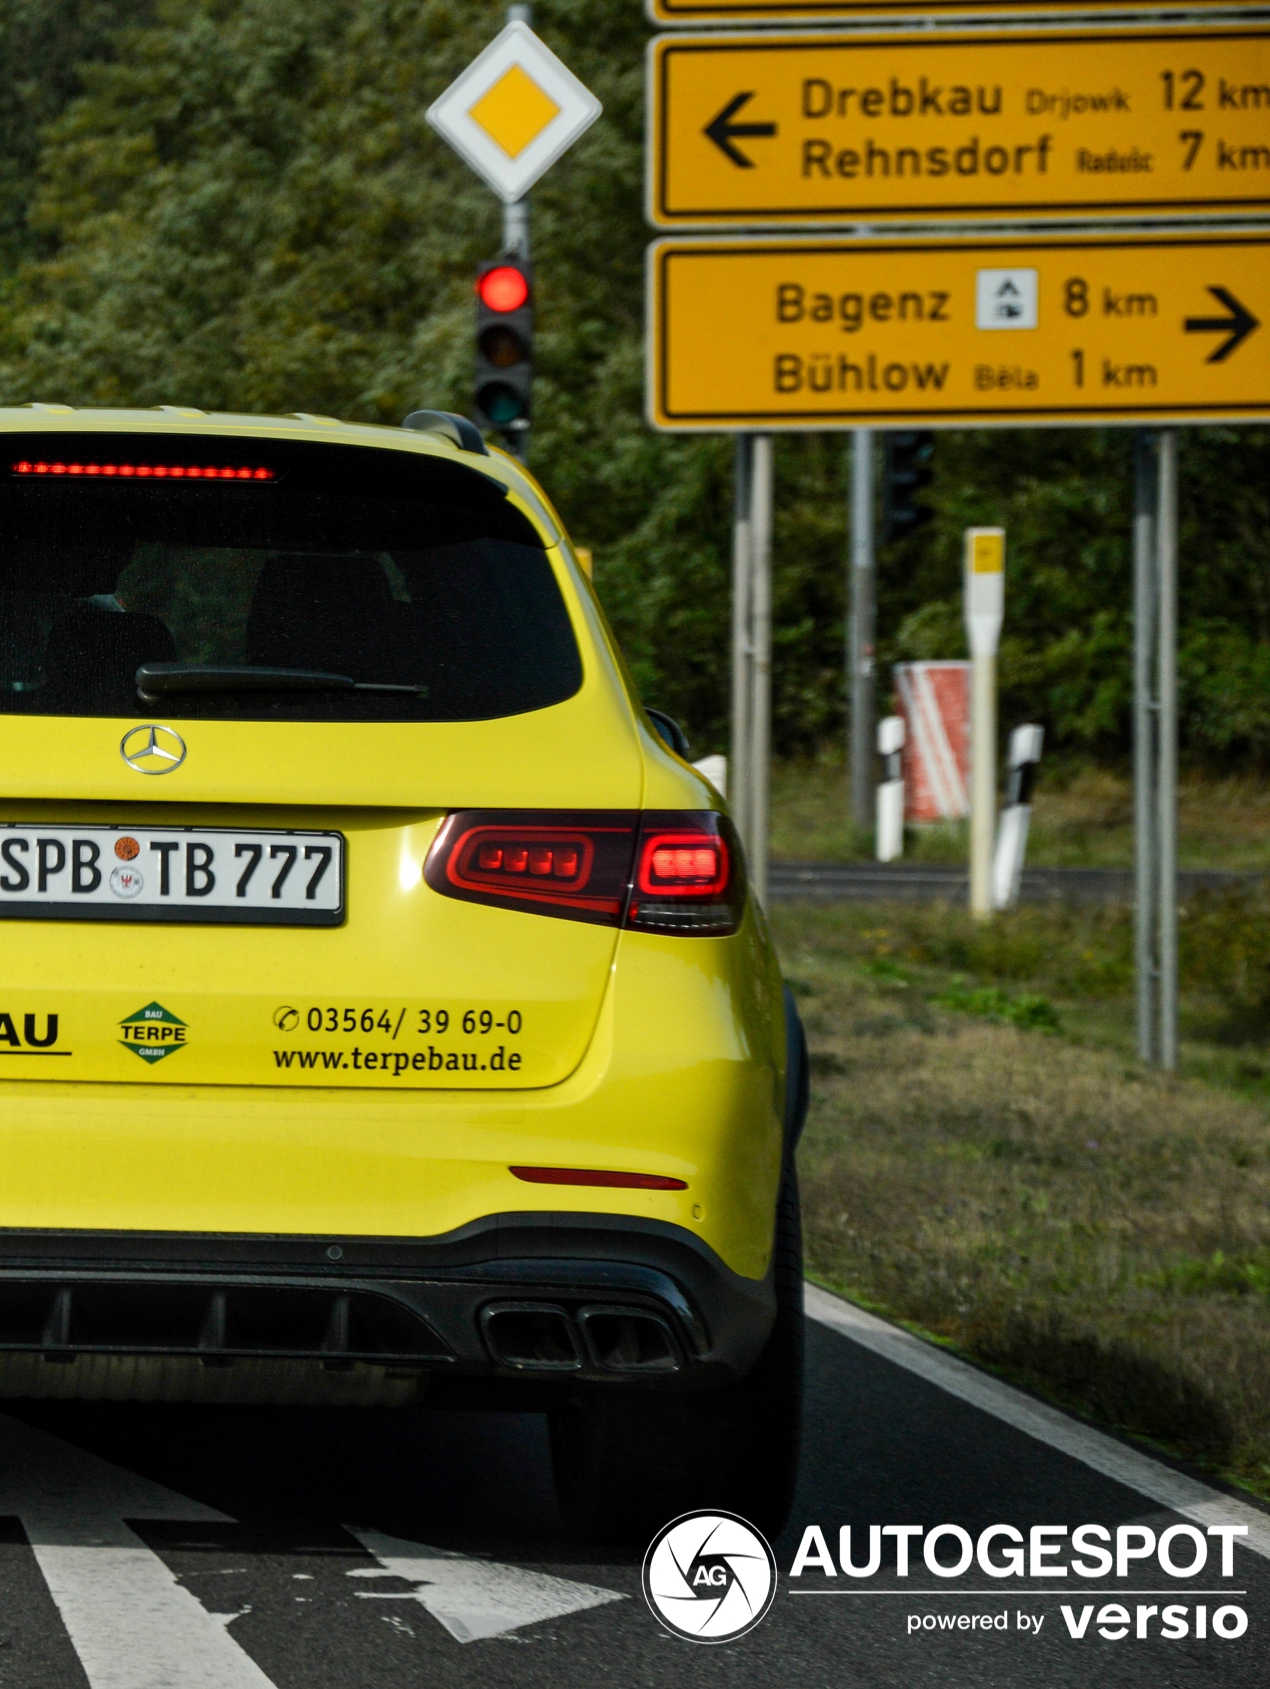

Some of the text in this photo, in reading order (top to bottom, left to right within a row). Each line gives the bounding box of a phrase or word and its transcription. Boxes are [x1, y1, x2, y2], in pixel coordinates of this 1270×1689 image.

[802, 76, 1002, 118] Drebkau
[1161, 69, 1205, 110] 12
[1219, 79, 1270, 109] km
[802, 134, 1052, 179] Rehnsdorf
[1180, 130, 1204, 171] 7
[1218, 139, 1270, 170] km
[777, 277, 1157, 333] Bagenz 8 km
[774, 353, 950, 393] Bühlow
[1071, 349, 1084, 388] 1
[1103, 358, 1157, 387] km
[0, 838, 332, 899] SPB TB 777
[121, 1026, 186, 1041] TERPE
[145, 1010, 163, 1018] BAU
[307, 1007, 522, 1040] 03564/ 39 69-0
[273, 1046, 522, 1076] www.terpebau.de
